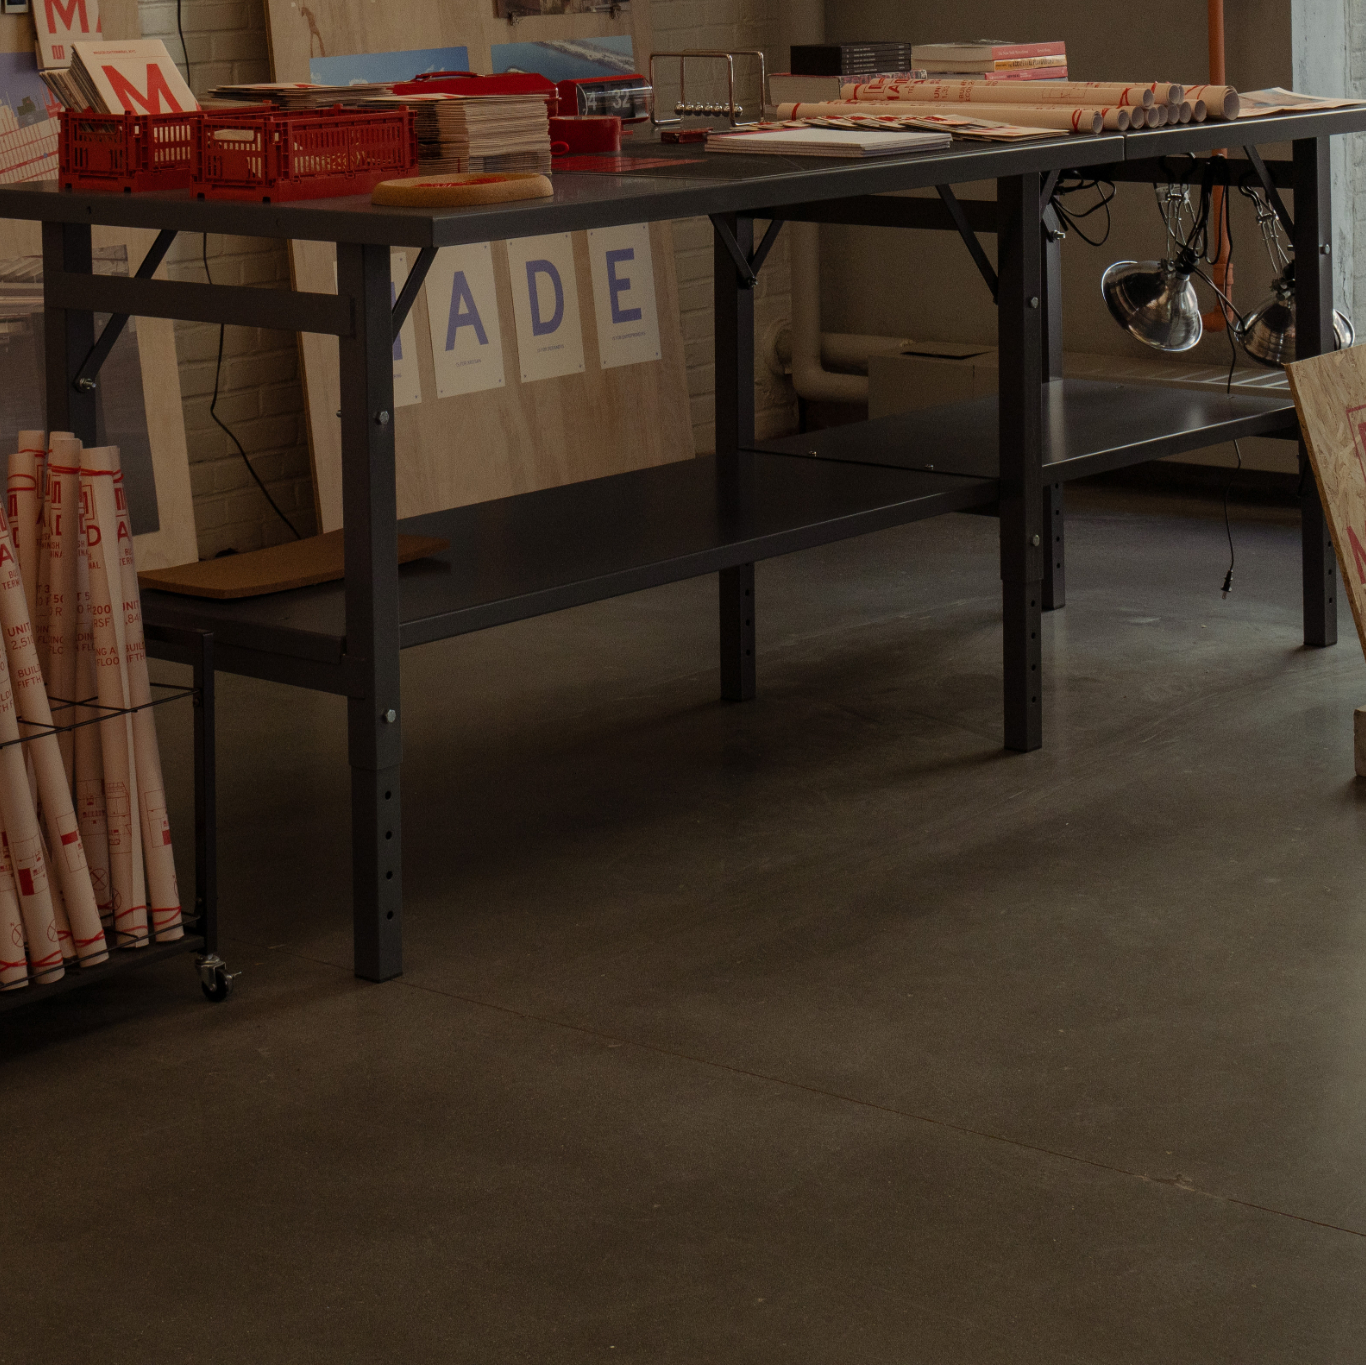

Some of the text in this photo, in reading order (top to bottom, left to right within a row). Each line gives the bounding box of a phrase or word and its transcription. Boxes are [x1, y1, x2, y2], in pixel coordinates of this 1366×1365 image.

[101, 63, 183, 115] M
[612, 88, 631, 109] 32
[445, 247, 642, 351] A D E
